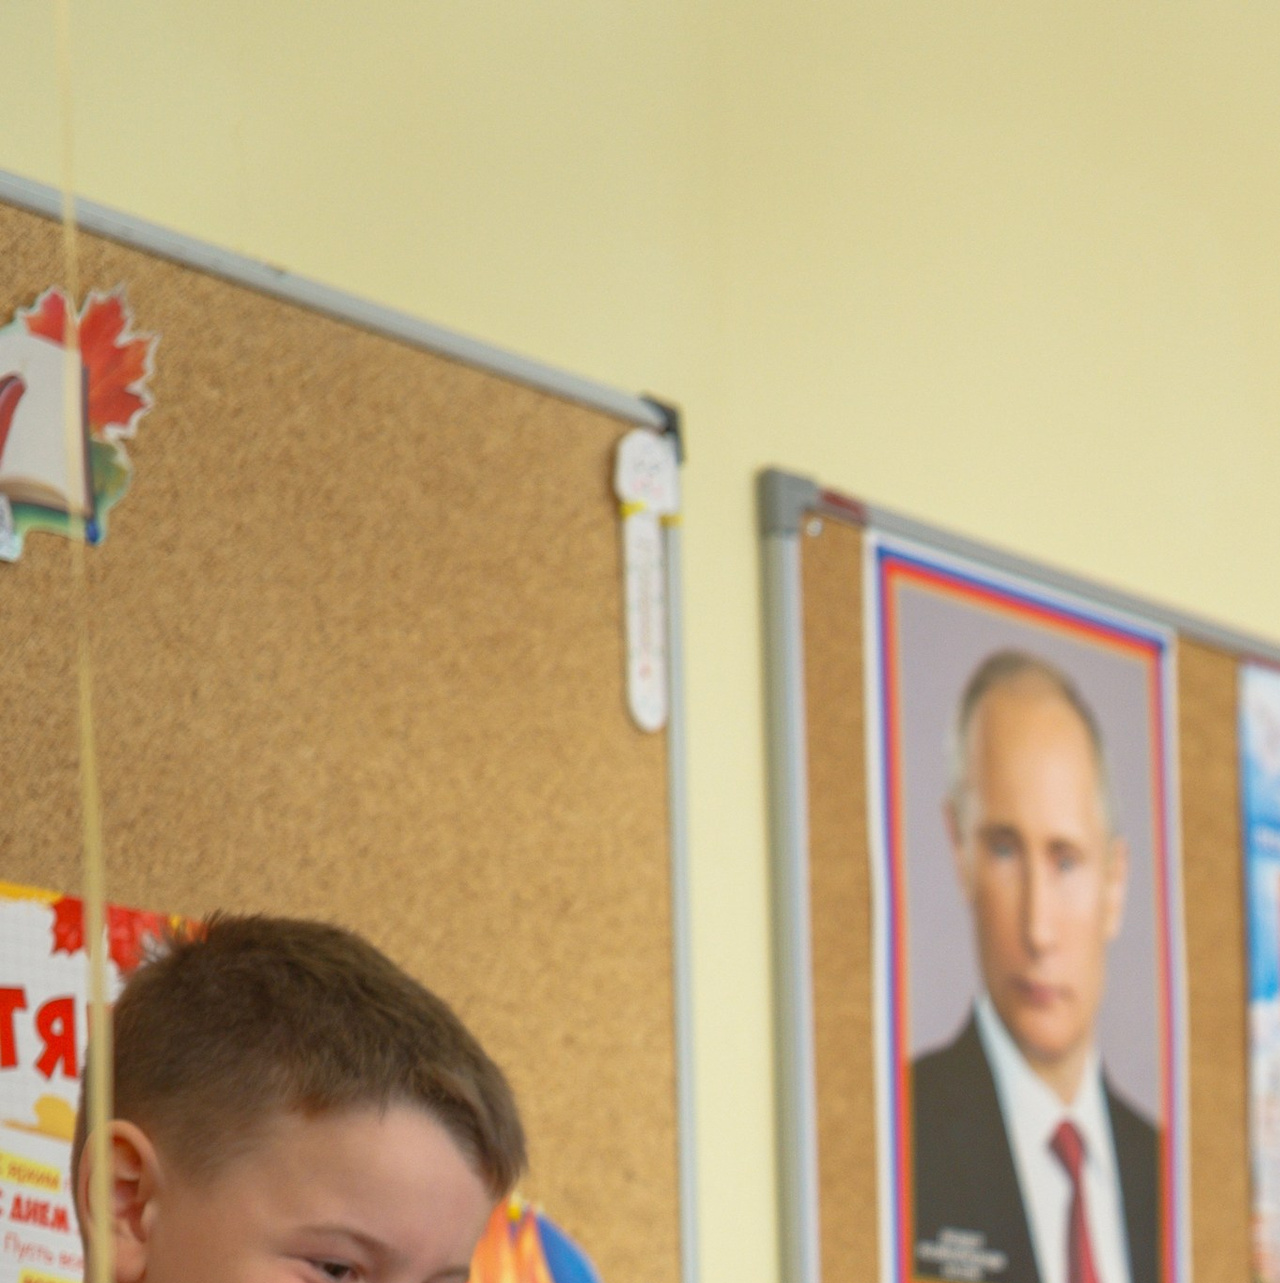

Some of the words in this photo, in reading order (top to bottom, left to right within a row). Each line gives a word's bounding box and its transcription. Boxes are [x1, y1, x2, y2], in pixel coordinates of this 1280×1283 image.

[0, 985, 110, 1080] ТЯ
[10, 1193, 70, 1231] ДНЕМ
[4, 1231, 53, 1265] Пусть
